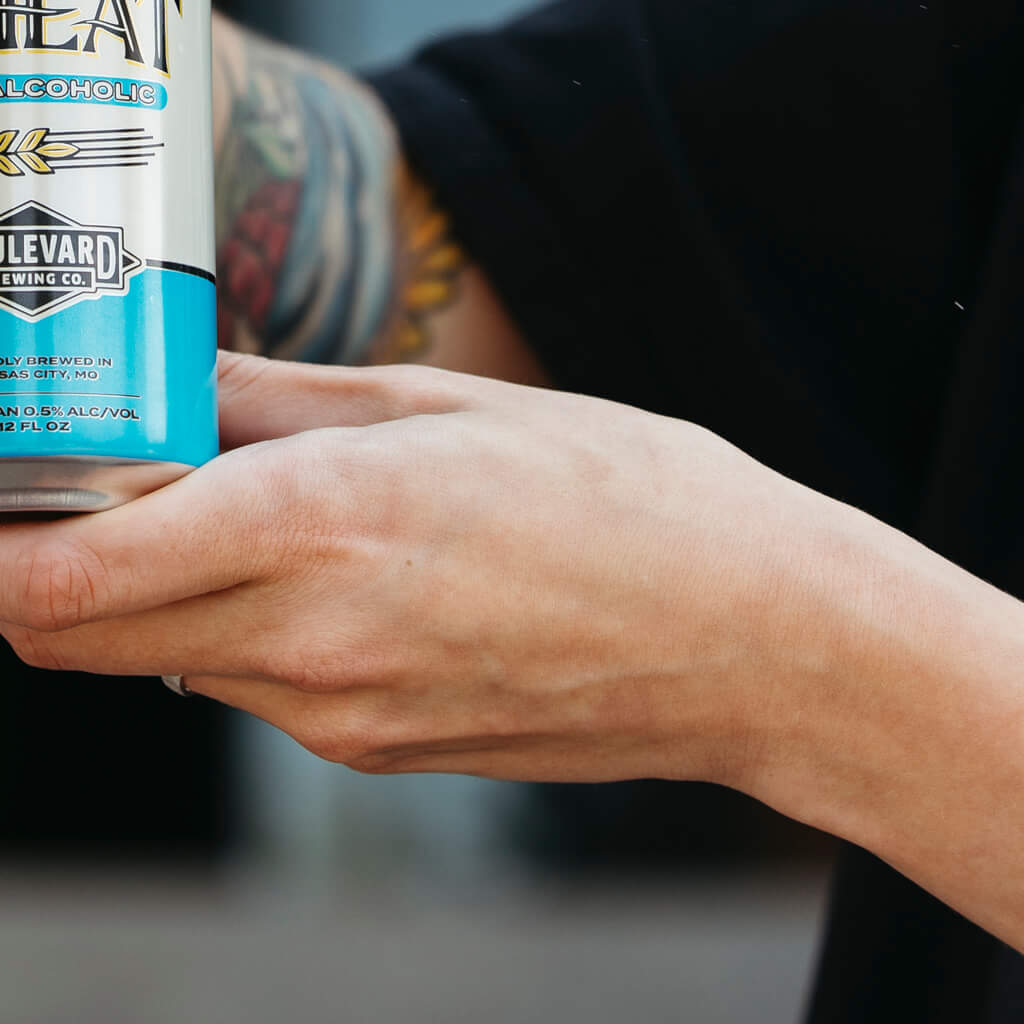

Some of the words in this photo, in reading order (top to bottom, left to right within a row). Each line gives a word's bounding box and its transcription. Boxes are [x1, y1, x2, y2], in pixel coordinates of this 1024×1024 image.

[61, 273, 87, 286] CO.
[26, 356, 94, 367] BREWED
[98, 357, 112, 367] IN
[33, 370, 71, 381] CITY,
[75, 370, 98, 379] MO
[23, 406, 64, 417] 0.5%
[67, 407, 140, 420] ALC/VOL
[20, 422, 42, 432] FL
[46, 421, 71, 432] OZ
